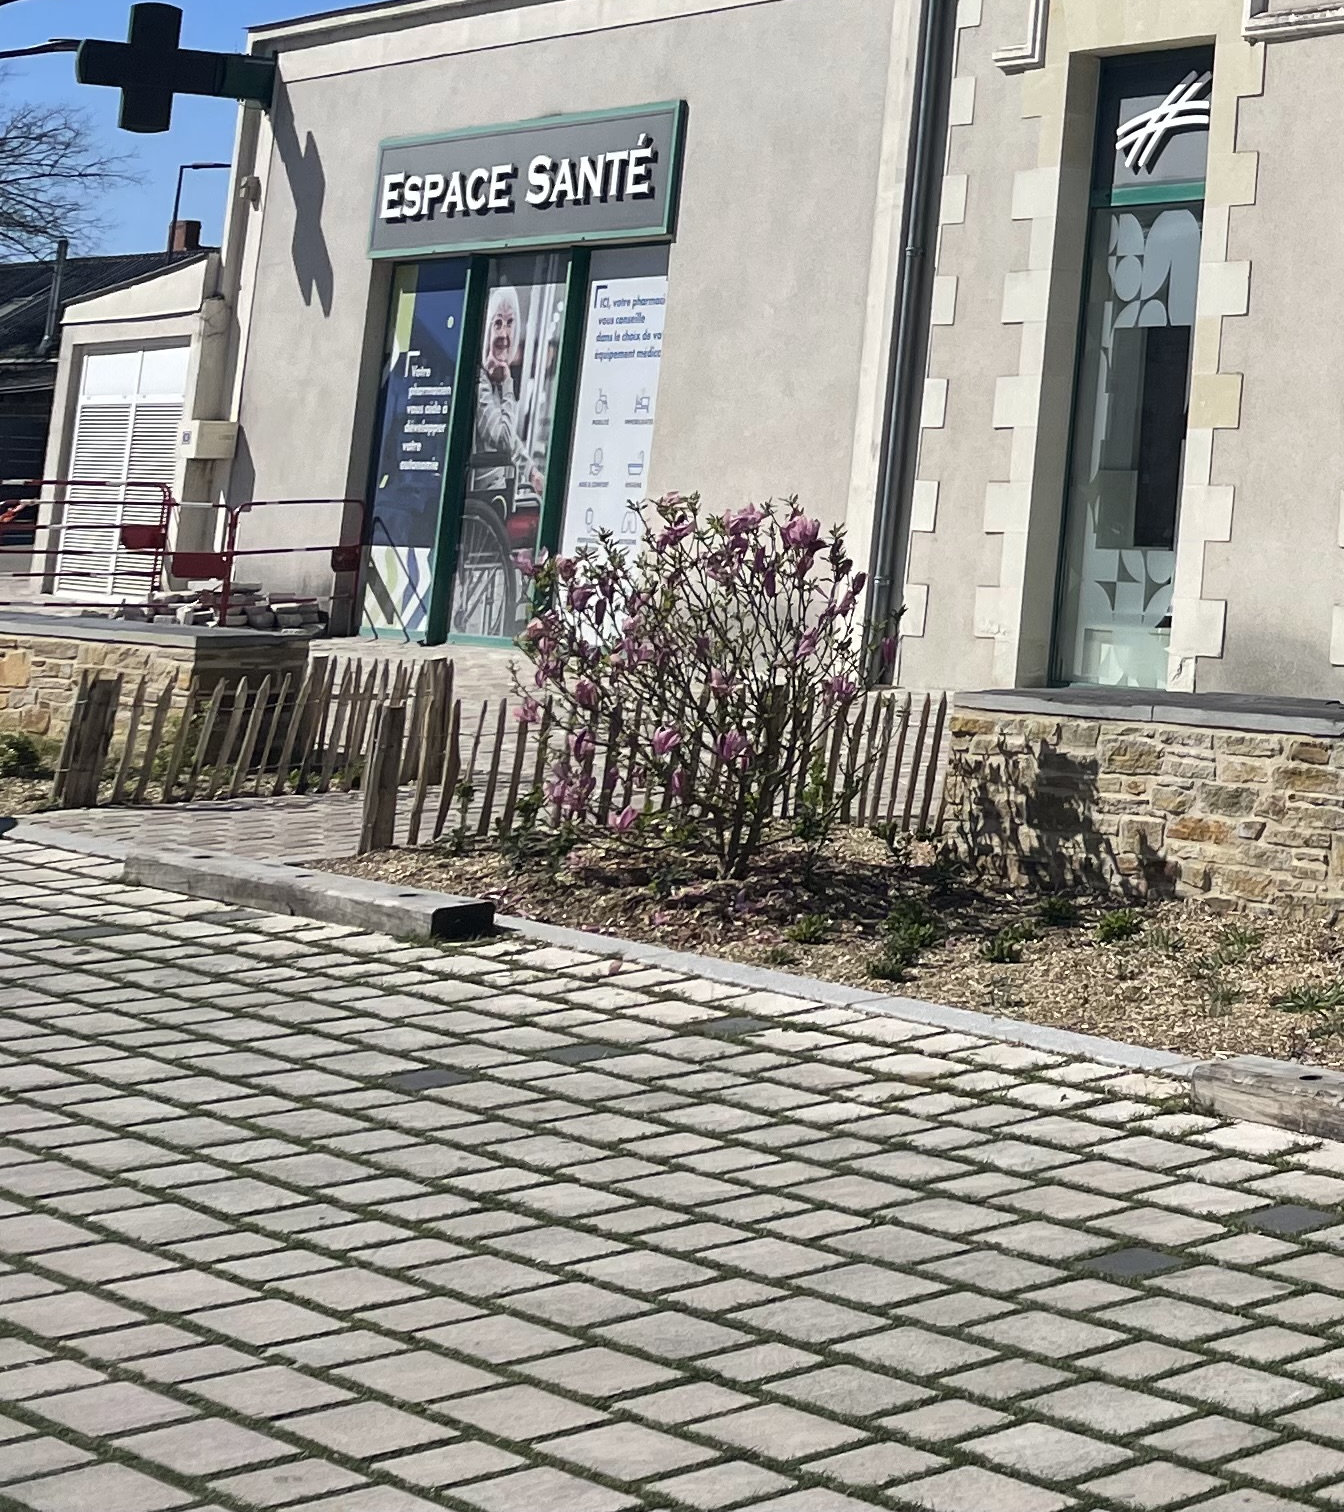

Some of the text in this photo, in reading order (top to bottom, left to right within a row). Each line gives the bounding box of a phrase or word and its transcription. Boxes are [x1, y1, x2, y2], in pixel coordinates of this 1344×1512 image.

[379, 132, 654, 219] ESPACE SANTÉ
[613, 298, 631, 307] votre
[599, 312, 646, 325] vous conseille
[614, 330, 621, 341] le
[642, 329, 651, 340] de
